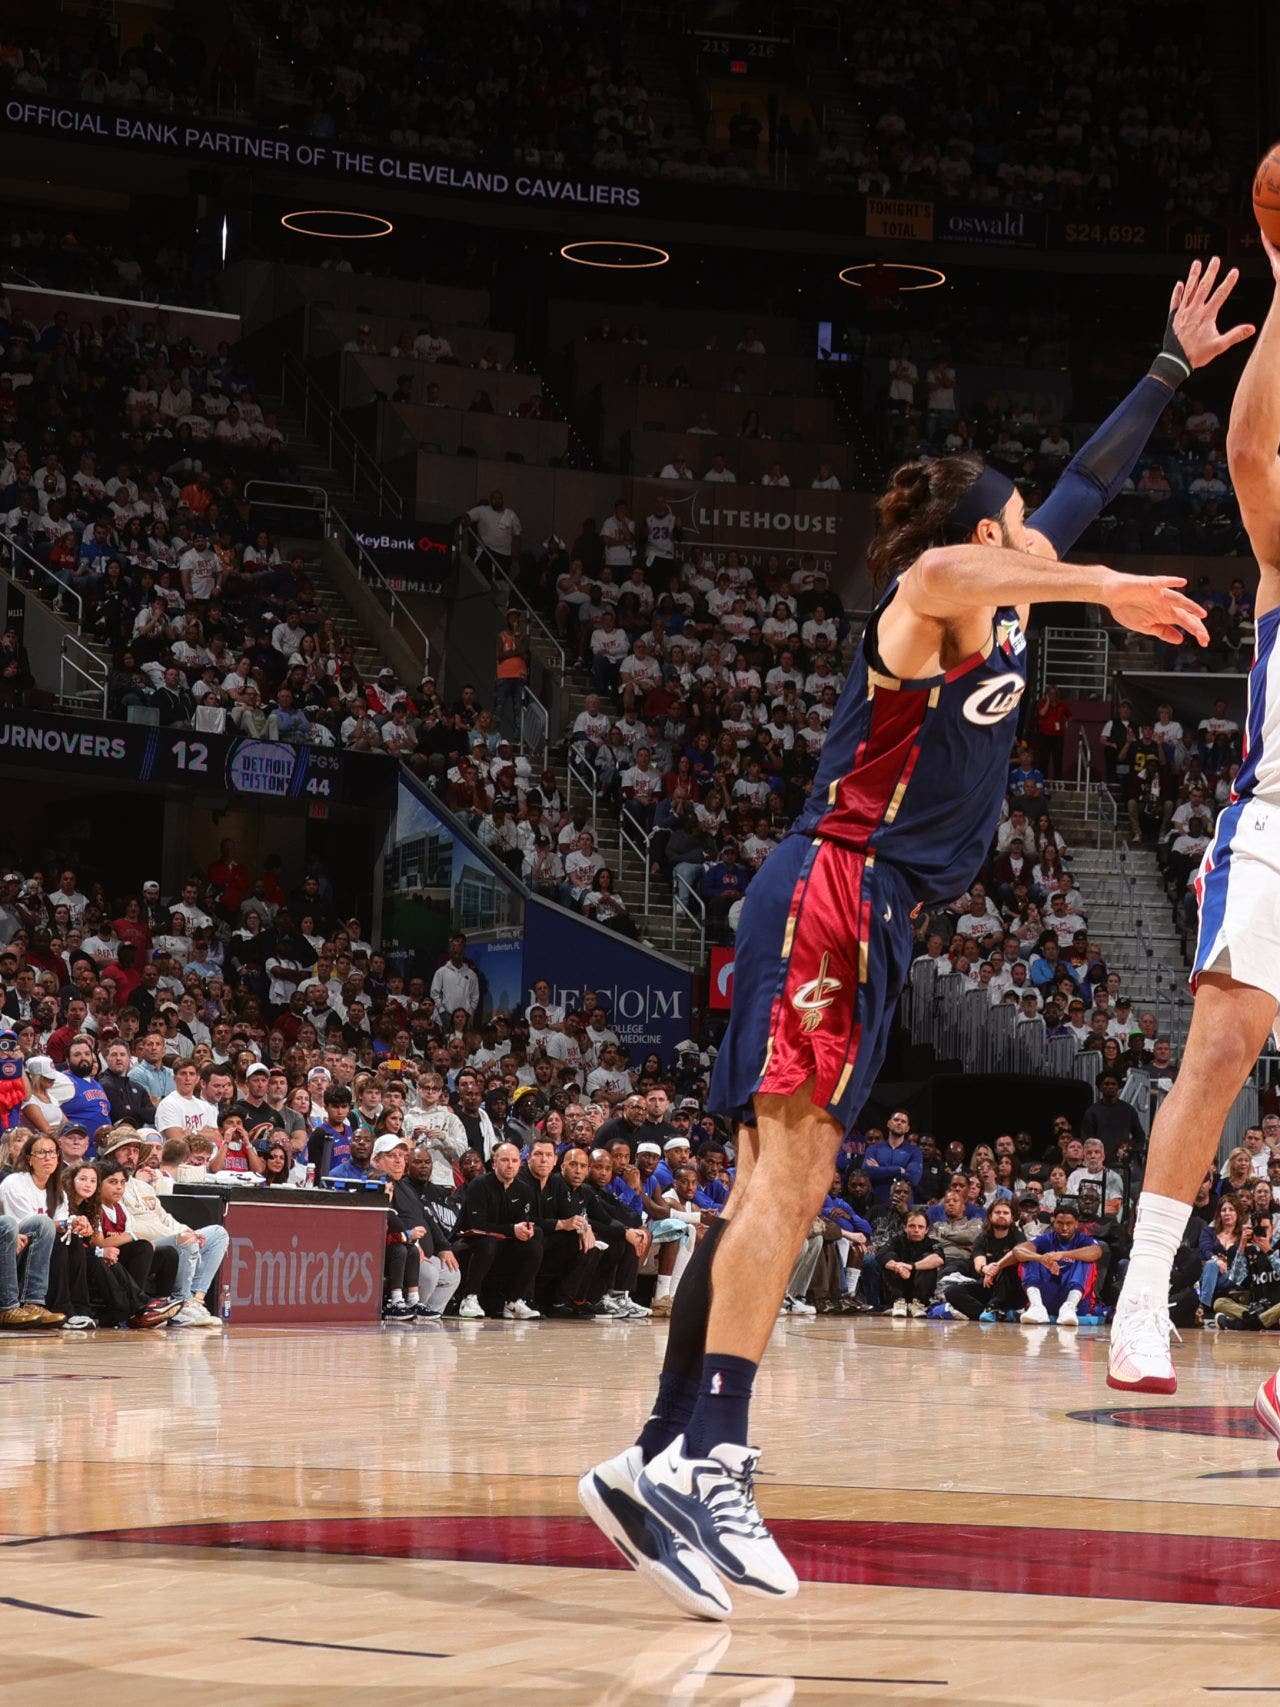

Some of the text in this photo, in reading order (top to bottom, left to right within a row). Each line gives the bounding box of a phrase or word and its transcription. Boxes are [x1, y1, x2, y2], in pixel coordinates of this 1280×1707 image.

[6, 101, 641, 207] OFFICIAL BANK PARTNER OF THE CLEVELAND CAVALIERS
[869, 201, 932, 219] TONIGHT'S
[882, 222, 916, 237] TOTAL
[949, 212, 1025, 238] oswald
[1065, 223, 1146, 244] $24,692
[699, 508, 838, 534] LITEHOUSE
[355, 532, 416, 551] KeyBank
[653, 527, 669, 539] 23
[171, 741, 208, 772] 12
[242, 755, 292, 776] DETROIT
[308, 754, 340, 771] FG%
[306, 777, 331, 797] 44
[619, 1034, 662, 1045] MEDICINE
[184, 1113, 204, 1129] BEAT
[230, 1235, 373, 1306] Emirates
